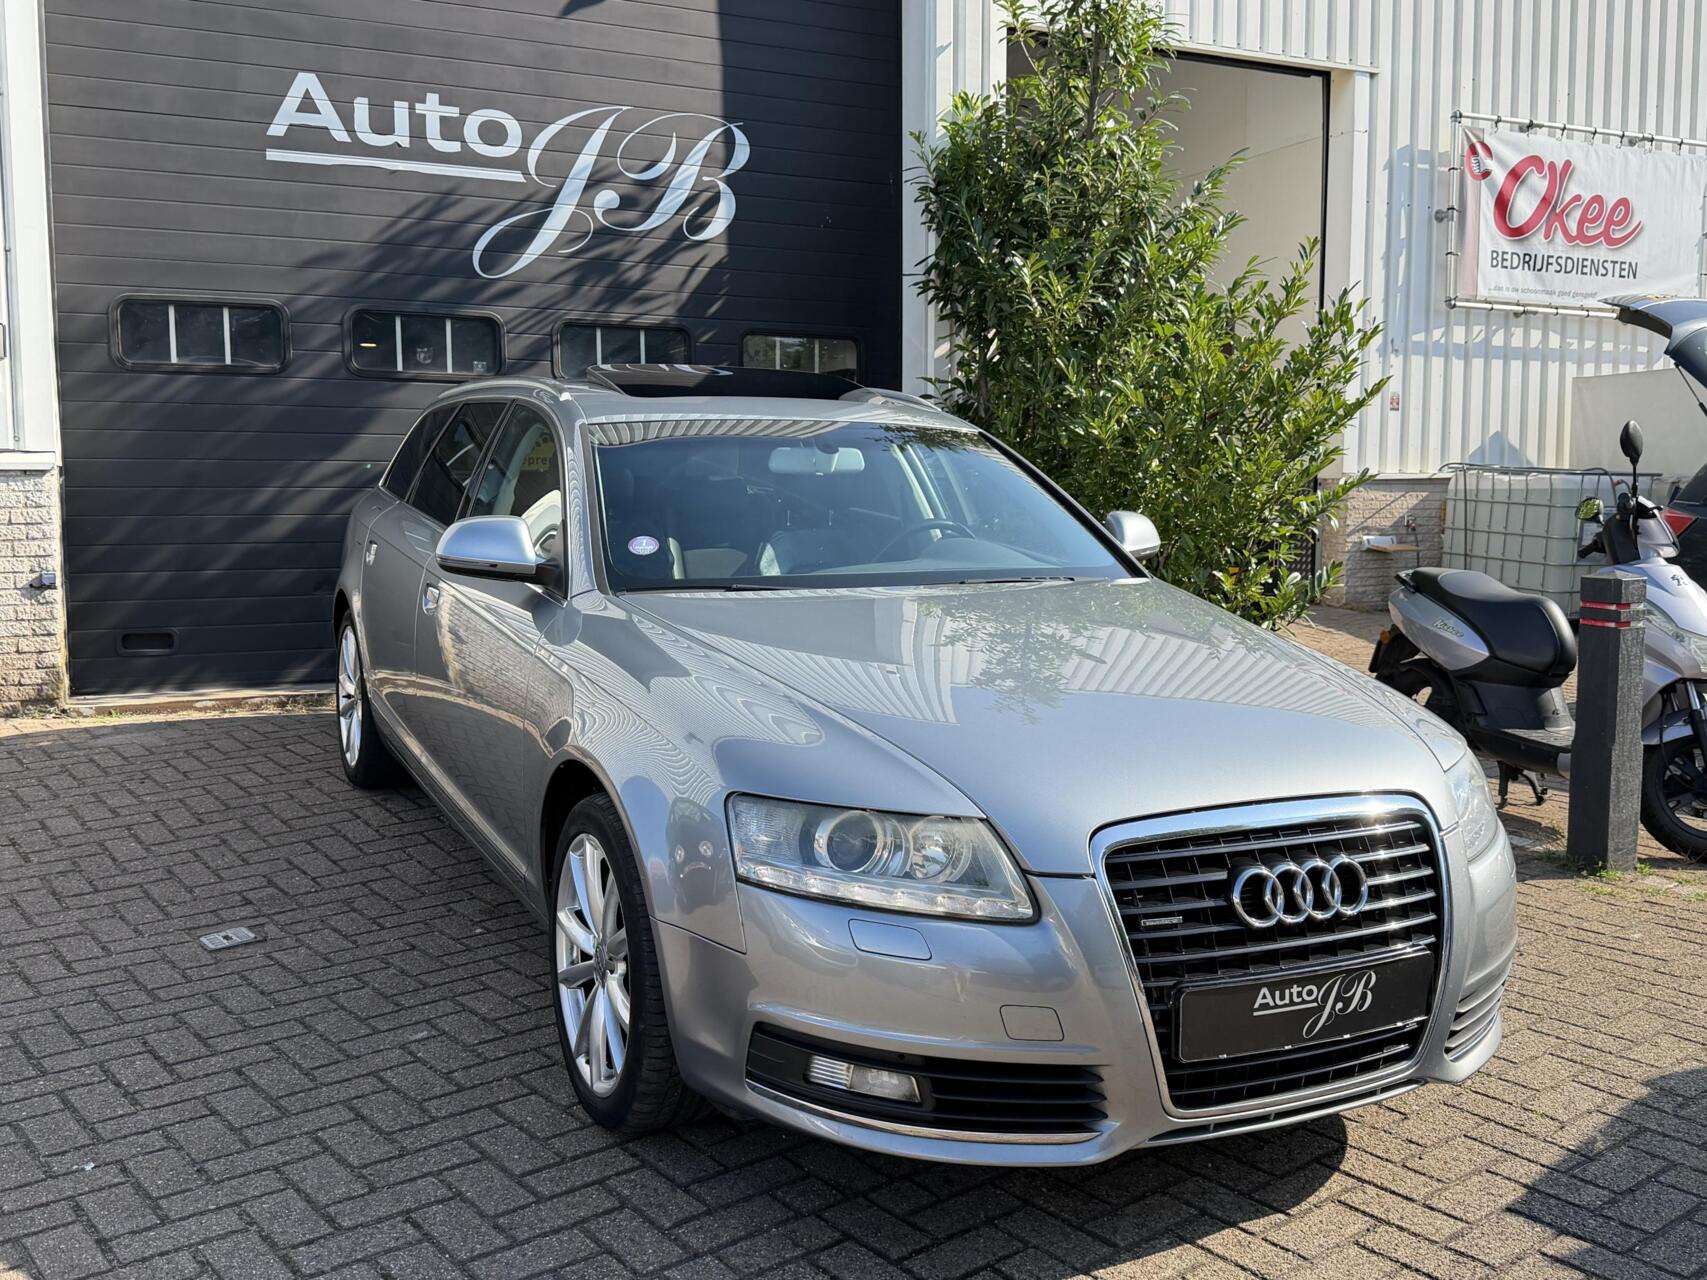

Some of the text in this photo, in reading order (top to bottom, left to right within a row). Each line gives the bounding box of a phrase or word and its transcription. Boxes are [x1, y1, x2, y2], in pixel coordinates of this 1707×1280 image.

[266, 72, 751, 280] Auto JB
[1490, 250, 1639, 280] BEDRIJFSDIENSTEN
[1253, 969, 1377, 1039] Auto JB
